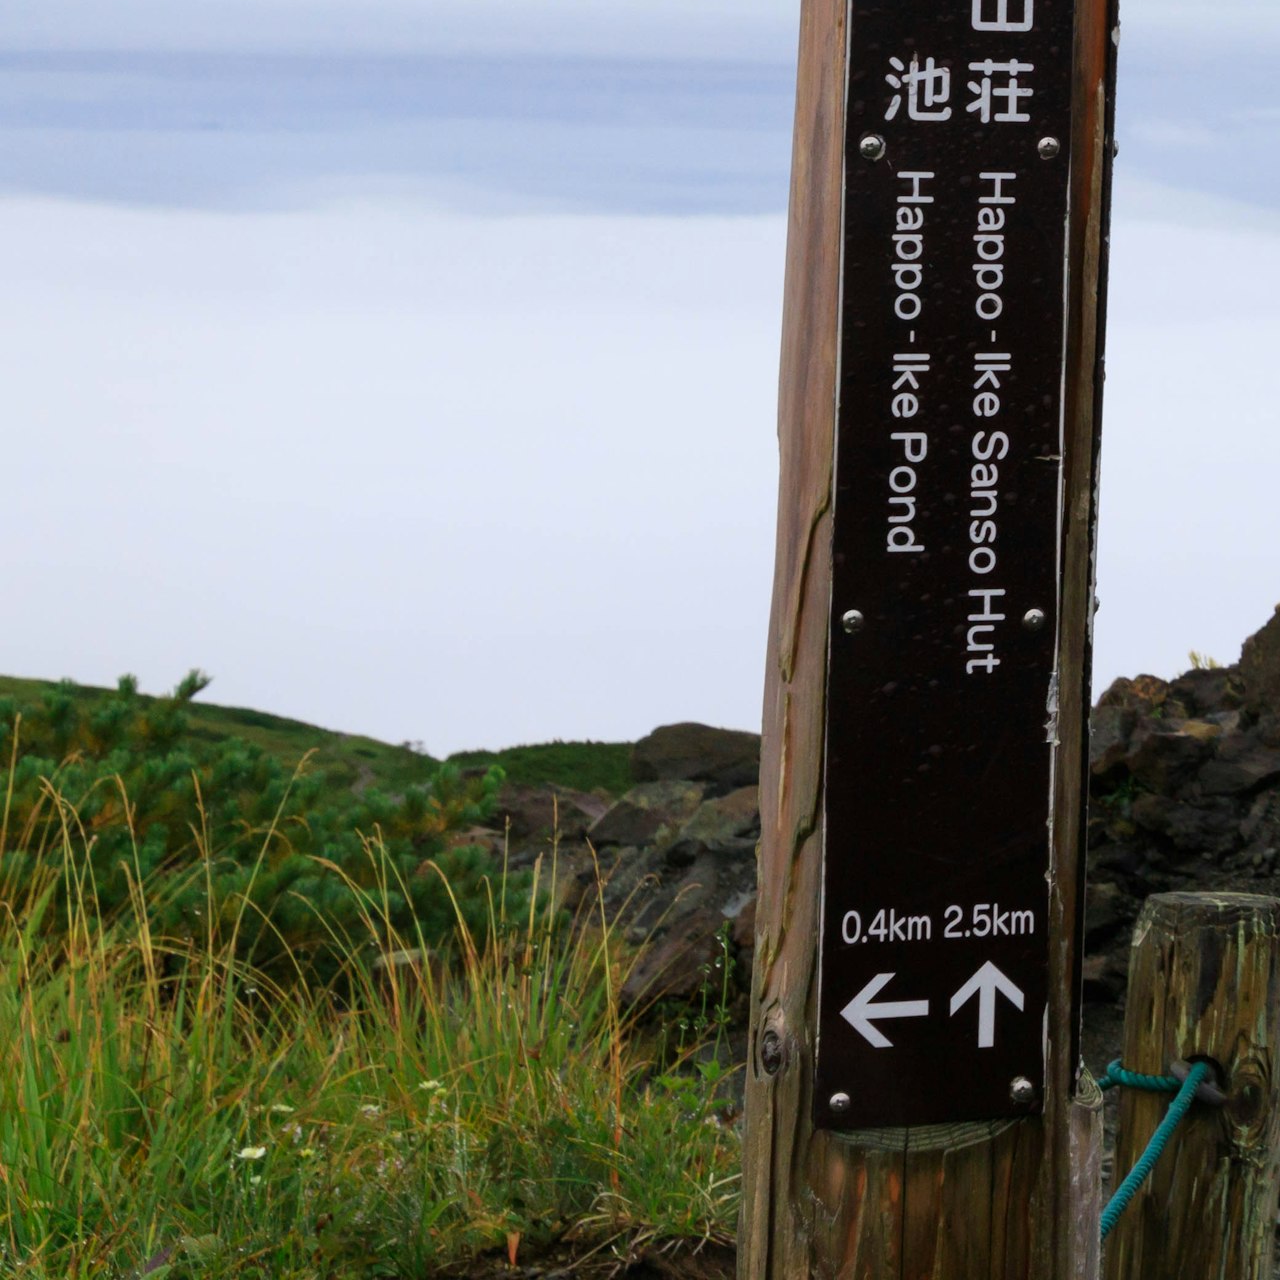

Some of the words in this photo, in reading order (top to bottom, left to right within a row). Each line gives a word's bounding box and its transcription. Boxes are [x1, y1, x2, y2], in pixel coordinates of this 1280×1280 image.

[886, 432, 928, 553] Pond
[968, 430, 1009, 575] Sanso
[966, 588, 1006, 676] Hut
[842, 908, 932, 945] 0.4km
[943, 902, 1035, 939] 2.5km
